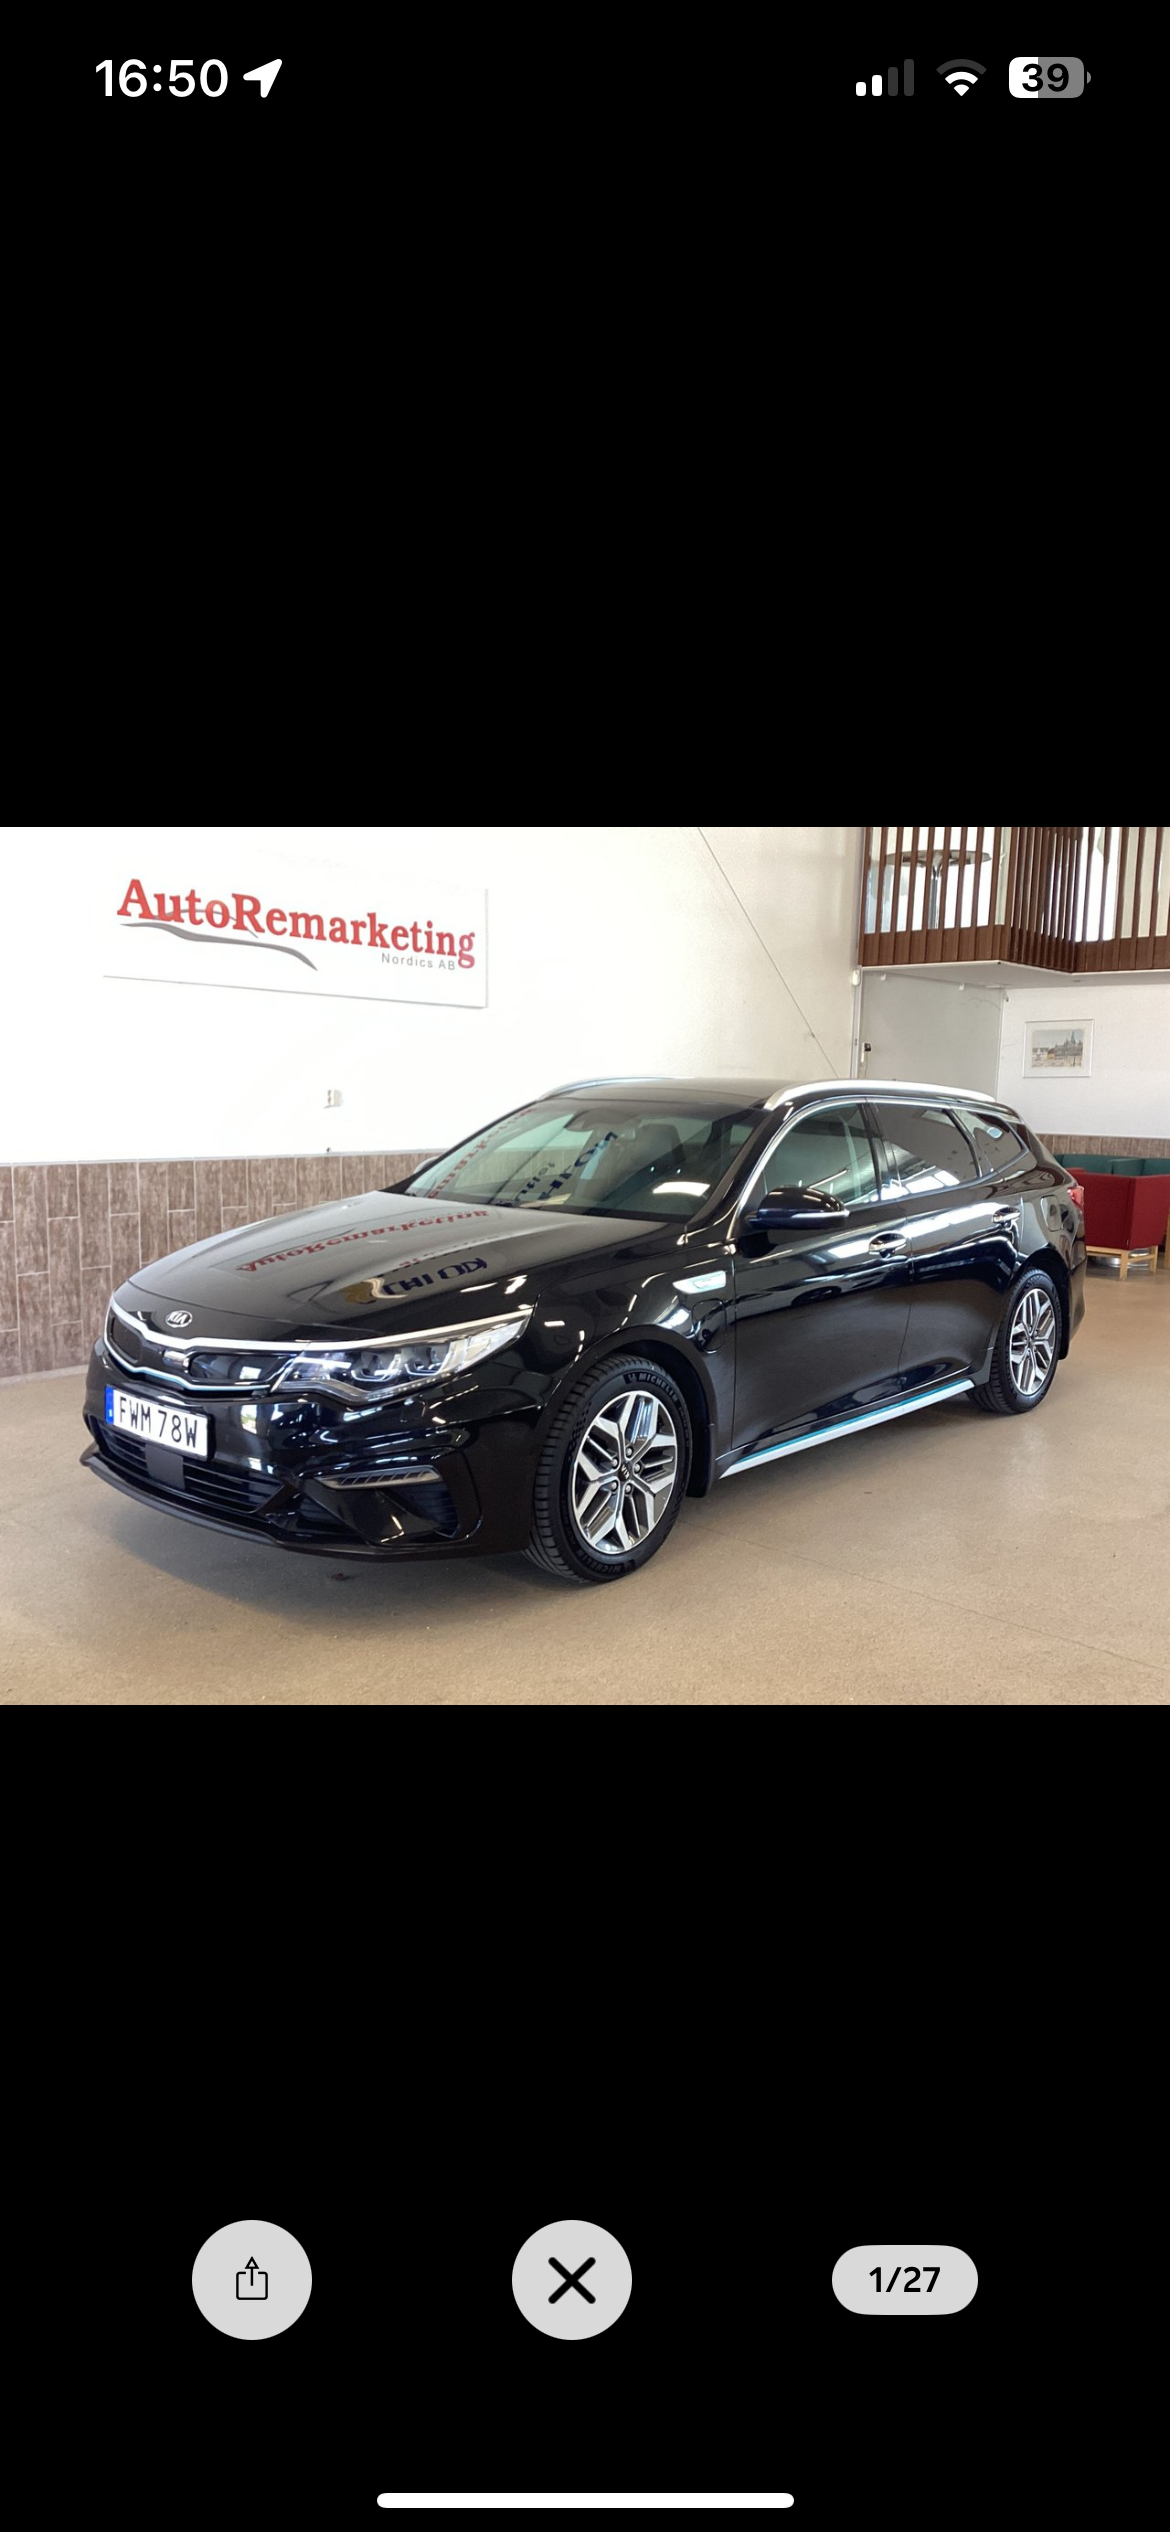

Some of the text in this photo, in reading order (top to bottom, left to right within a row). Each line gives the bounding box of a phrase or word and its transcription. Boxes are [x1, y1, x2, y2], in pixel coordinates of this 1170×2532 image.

[117, 879, 475, 968] AutoRemarketing
[381, 952, 455, 970] Nordics AB
[120, 1396, 198, 1448] FWM 78W
